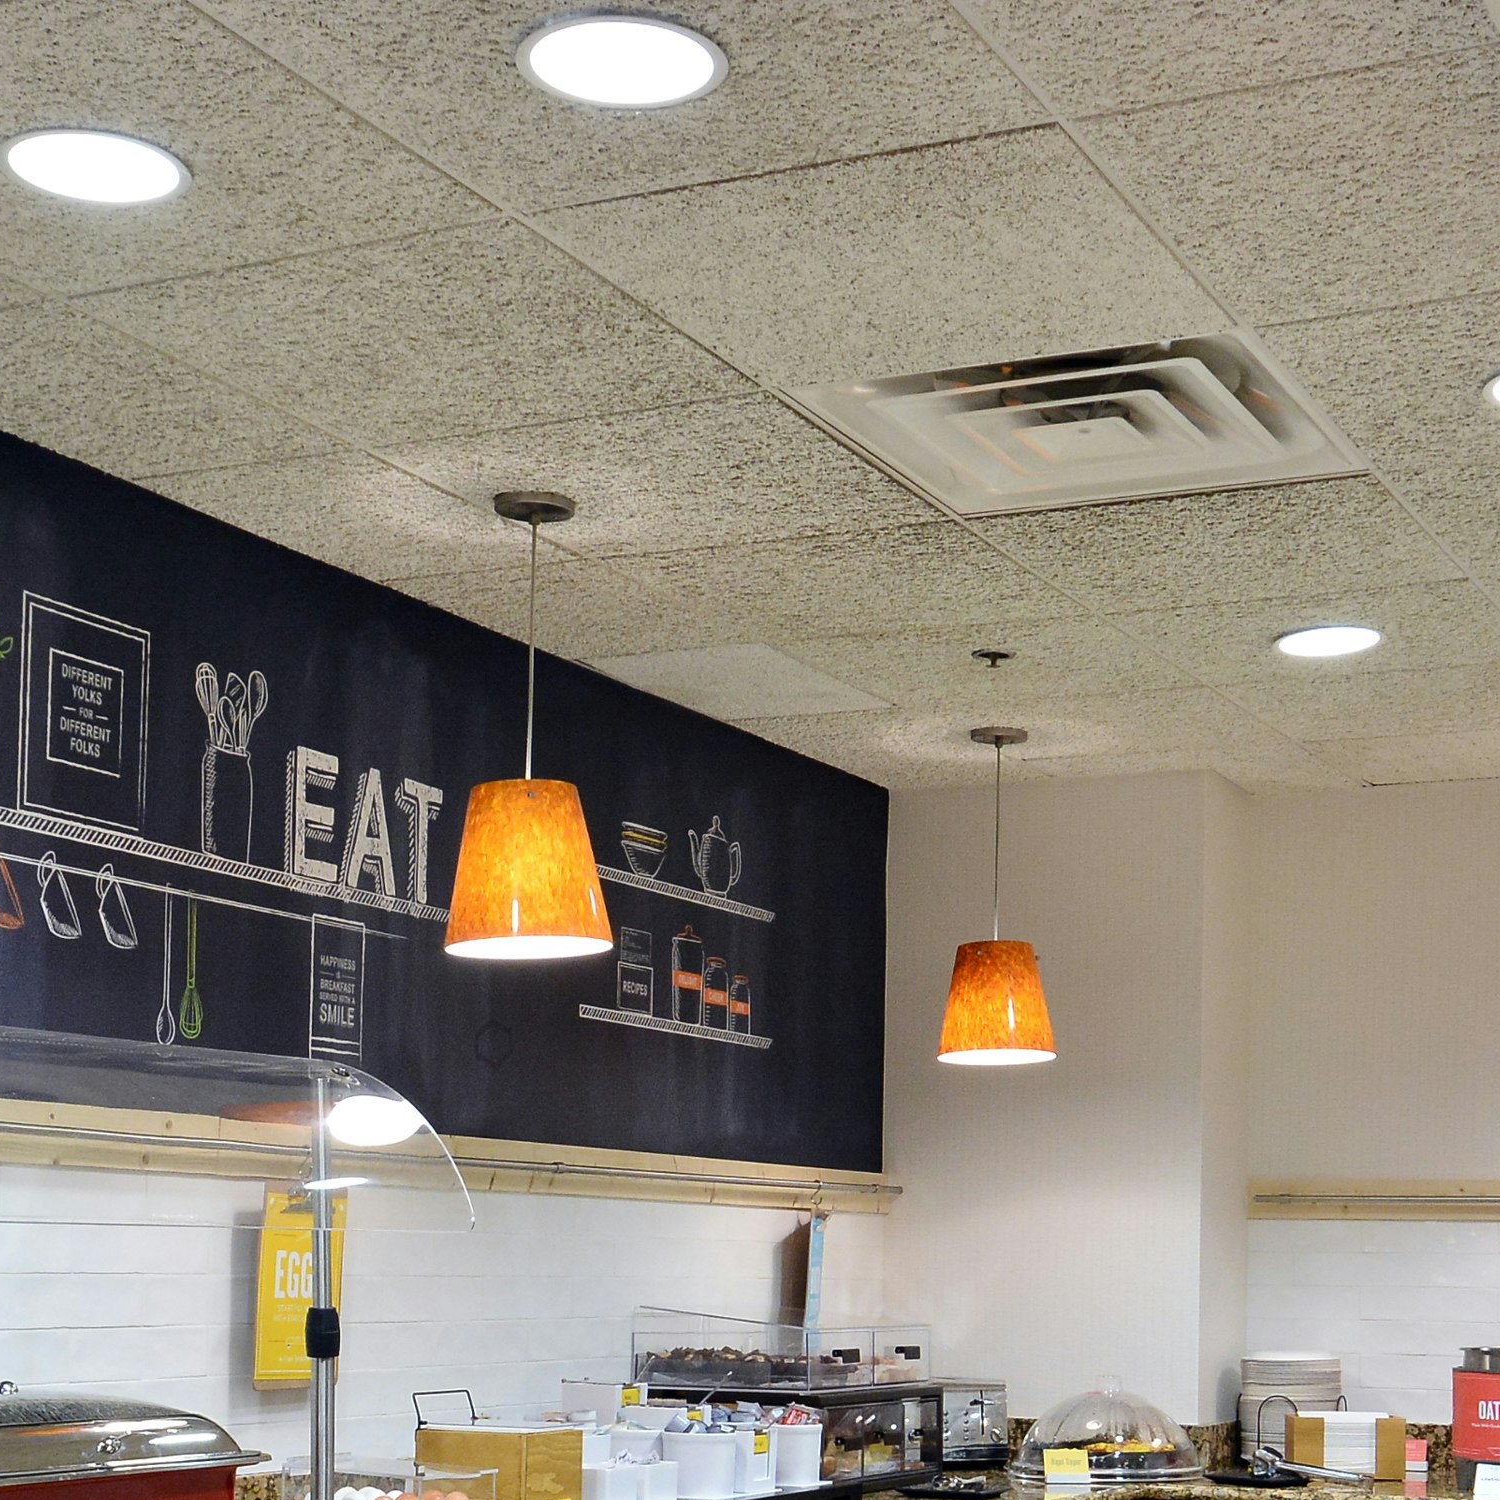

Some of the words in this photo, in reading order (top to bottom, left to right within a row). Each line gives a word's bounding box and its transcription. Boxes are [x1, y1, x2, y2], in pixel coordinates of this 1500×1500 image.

[61, 663, 113, 691] DIFFERENT
[71, 684, 102, 706] YOLKS
[78, 706, 94, 720] FOR
[60, 716, 112, 743] DIFFERENT
[70, 737, 101, 758] FOLKS
[285, 745, 443, 904] EAT
[320, 954, 356, 972] HAPPINESS
[320, 978, 355, 994] BREAKFAST
[622, 980, 648, 997] RECIPES
[319, 1002, 355, 1027] SMILE
[274, 1250, 313, 1299] EGG
